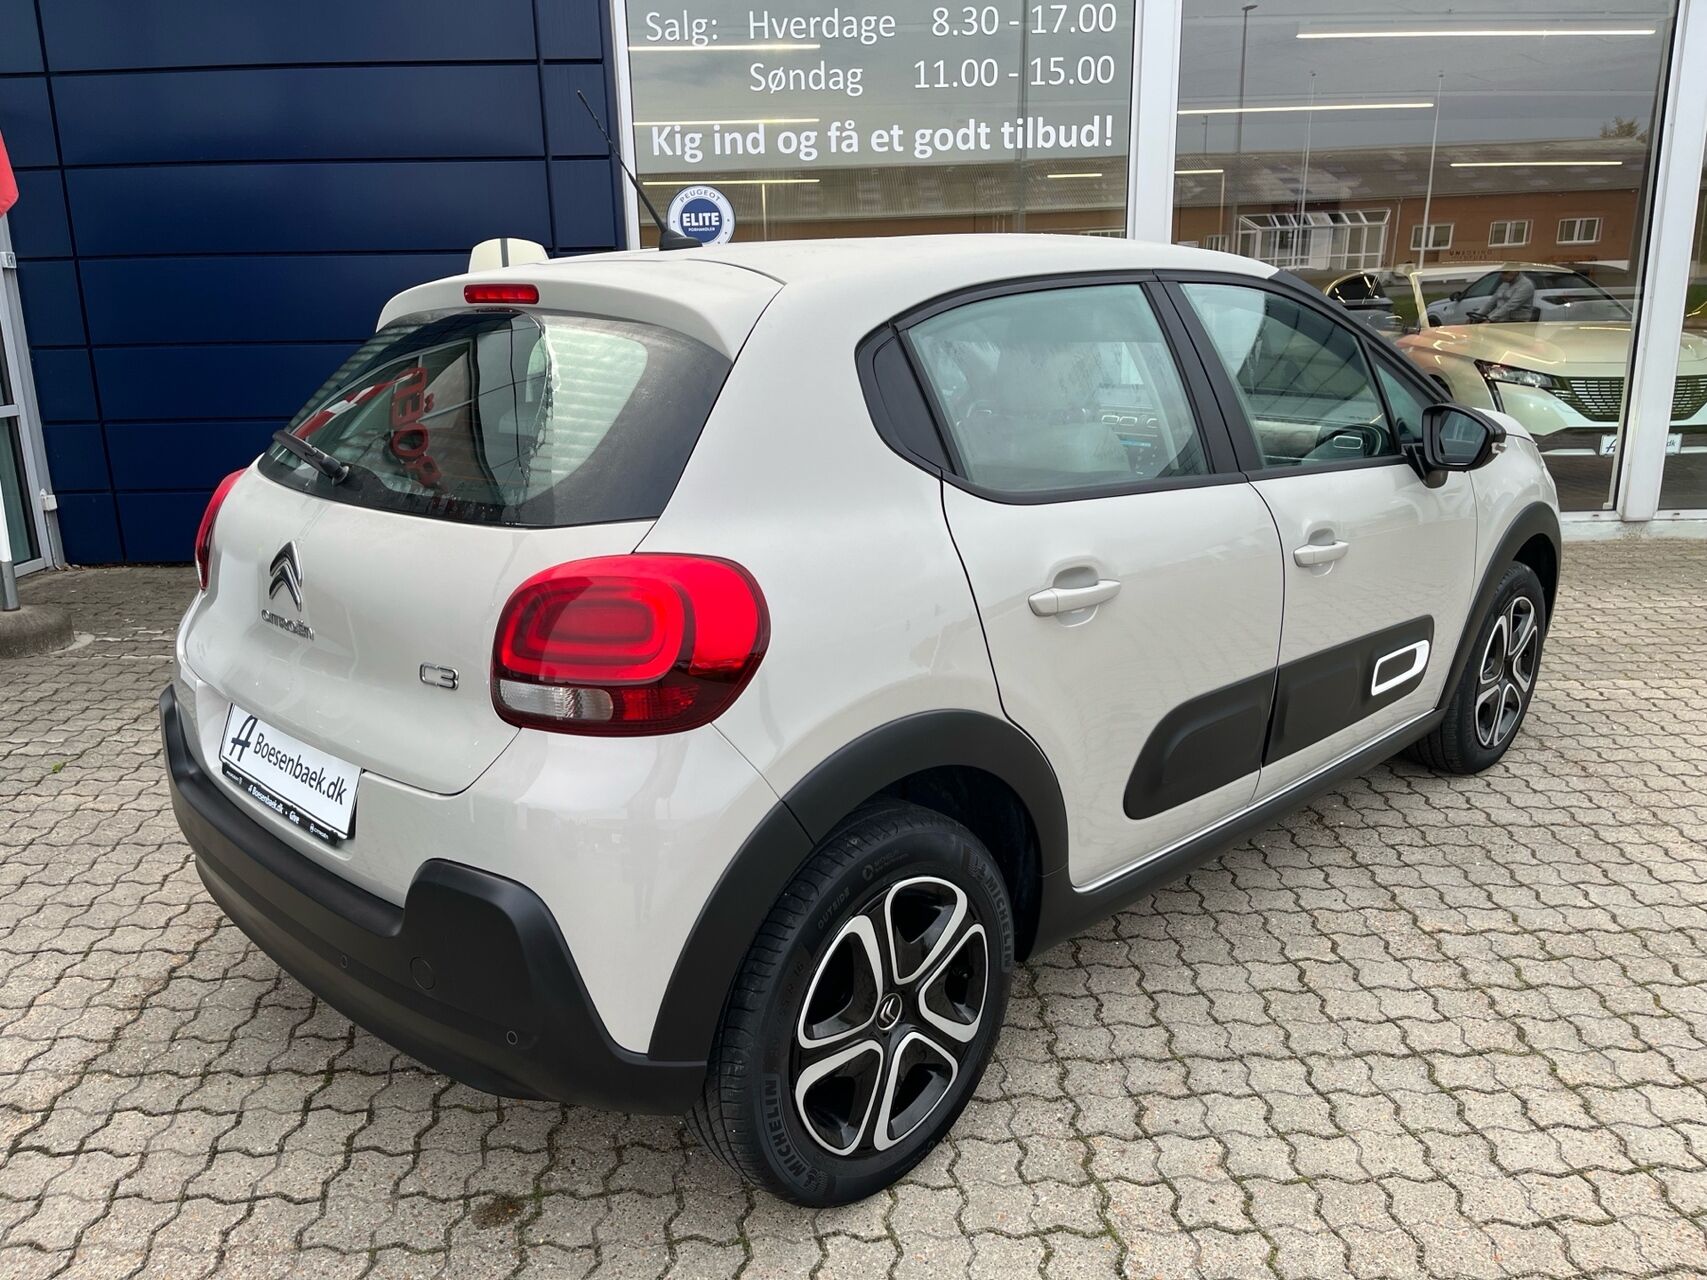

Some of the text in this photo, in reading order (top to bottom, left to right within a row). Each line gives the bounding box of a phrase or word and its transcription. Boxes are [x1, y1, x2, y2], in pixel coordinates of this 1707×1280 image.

[645, 9, 718, 47] Salg:
[749, 8, 896, 44] Hverdage
[931, 6, 999, 36] 8.30
[1031, 3, 1117, 33] 17.00
[749, 60, 863, 96] Søndag
[914, 58, 999, 89] 11.00
[1030, 55, 1115, 86] 15.00
[651, 115, 1113, 163] Kig ind og få et godt tilbud!
[679, 188, 721, 203] PEUGEOT
[681, 212, 720, 227] ELITE
[261, 609, 315, 641] CITROËN
[419, 662, 459, 690] C3
[253, 733, 347, 805] Boesenbaek.dk
[289, 811, 300, 825] Give
[818, 887, 850, 930] OUTSIDE
[986, 876, 1013, 969] MICHELIN
[764, 1080, 806, 1177] MICHELIN
